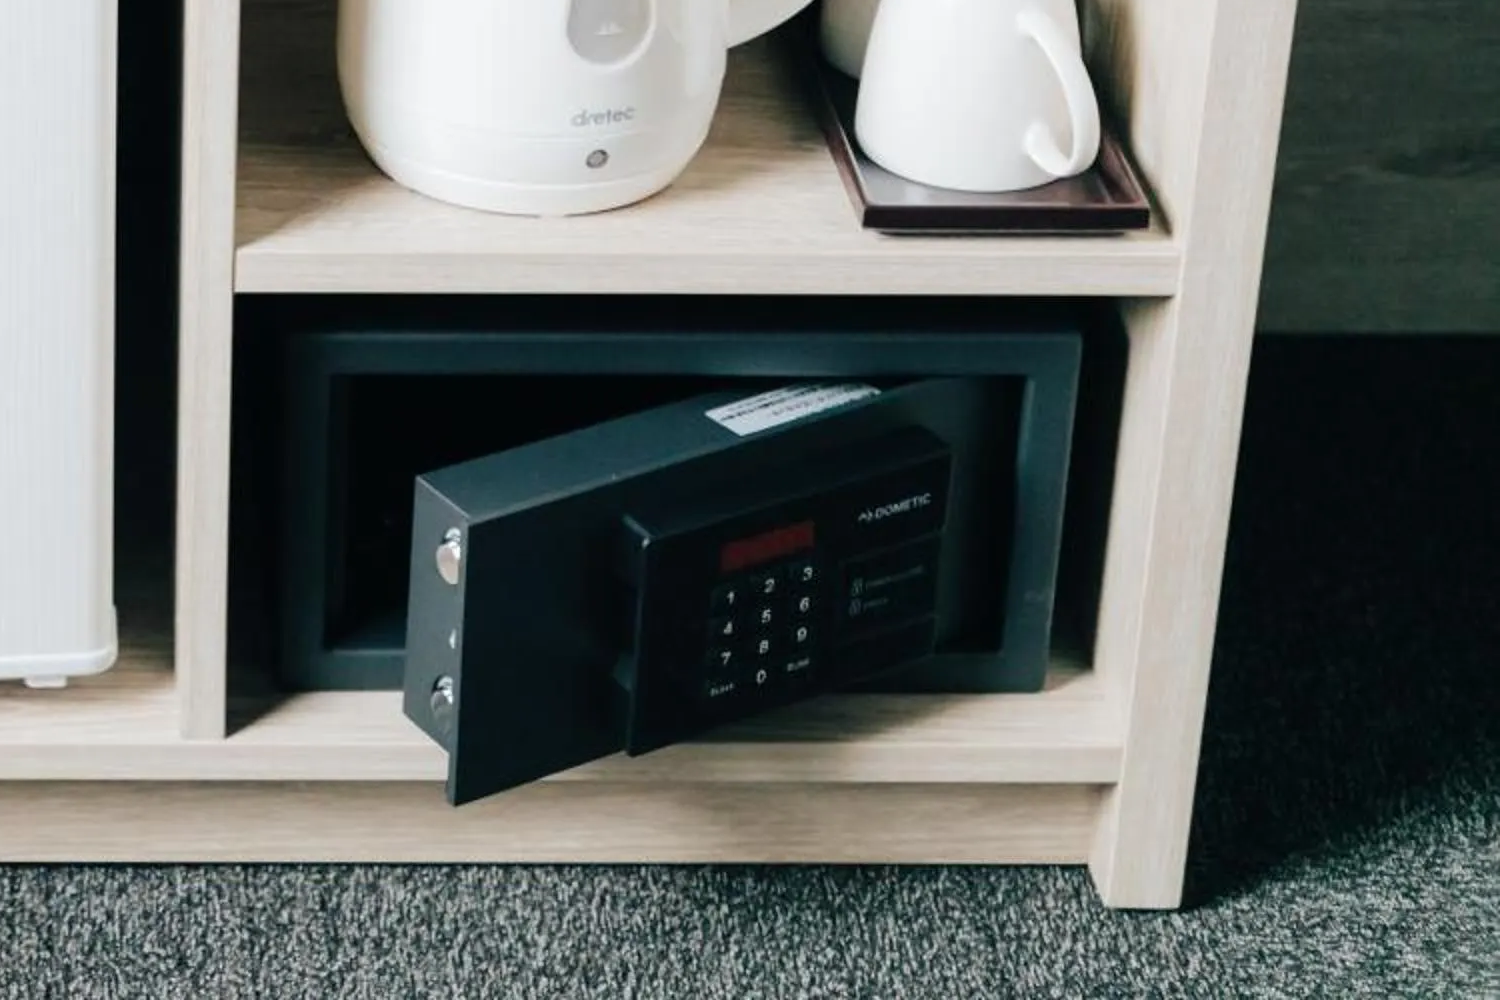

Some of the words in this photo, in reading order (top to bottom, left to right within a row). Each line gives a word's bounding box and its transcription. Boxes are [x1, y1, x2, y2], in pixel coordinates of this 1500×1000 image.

[571, 107, 636, 127] dretec
[874, 492, 932, 519] DOMETIC
[727, 591, 735, 604] 1
[764, 578, 775, 593] 2
[802, 566, 813, 581] 3
[723, 621, 733, 635] 4
[761, 608, 772, 623] 5
[799, 597, 810, 612] 6
[720, 651, 732, 666] 7
[759, 639, 769, 654] 8
[797, 626, 808, 642] 9
[756, 669, 767, 684] 0
